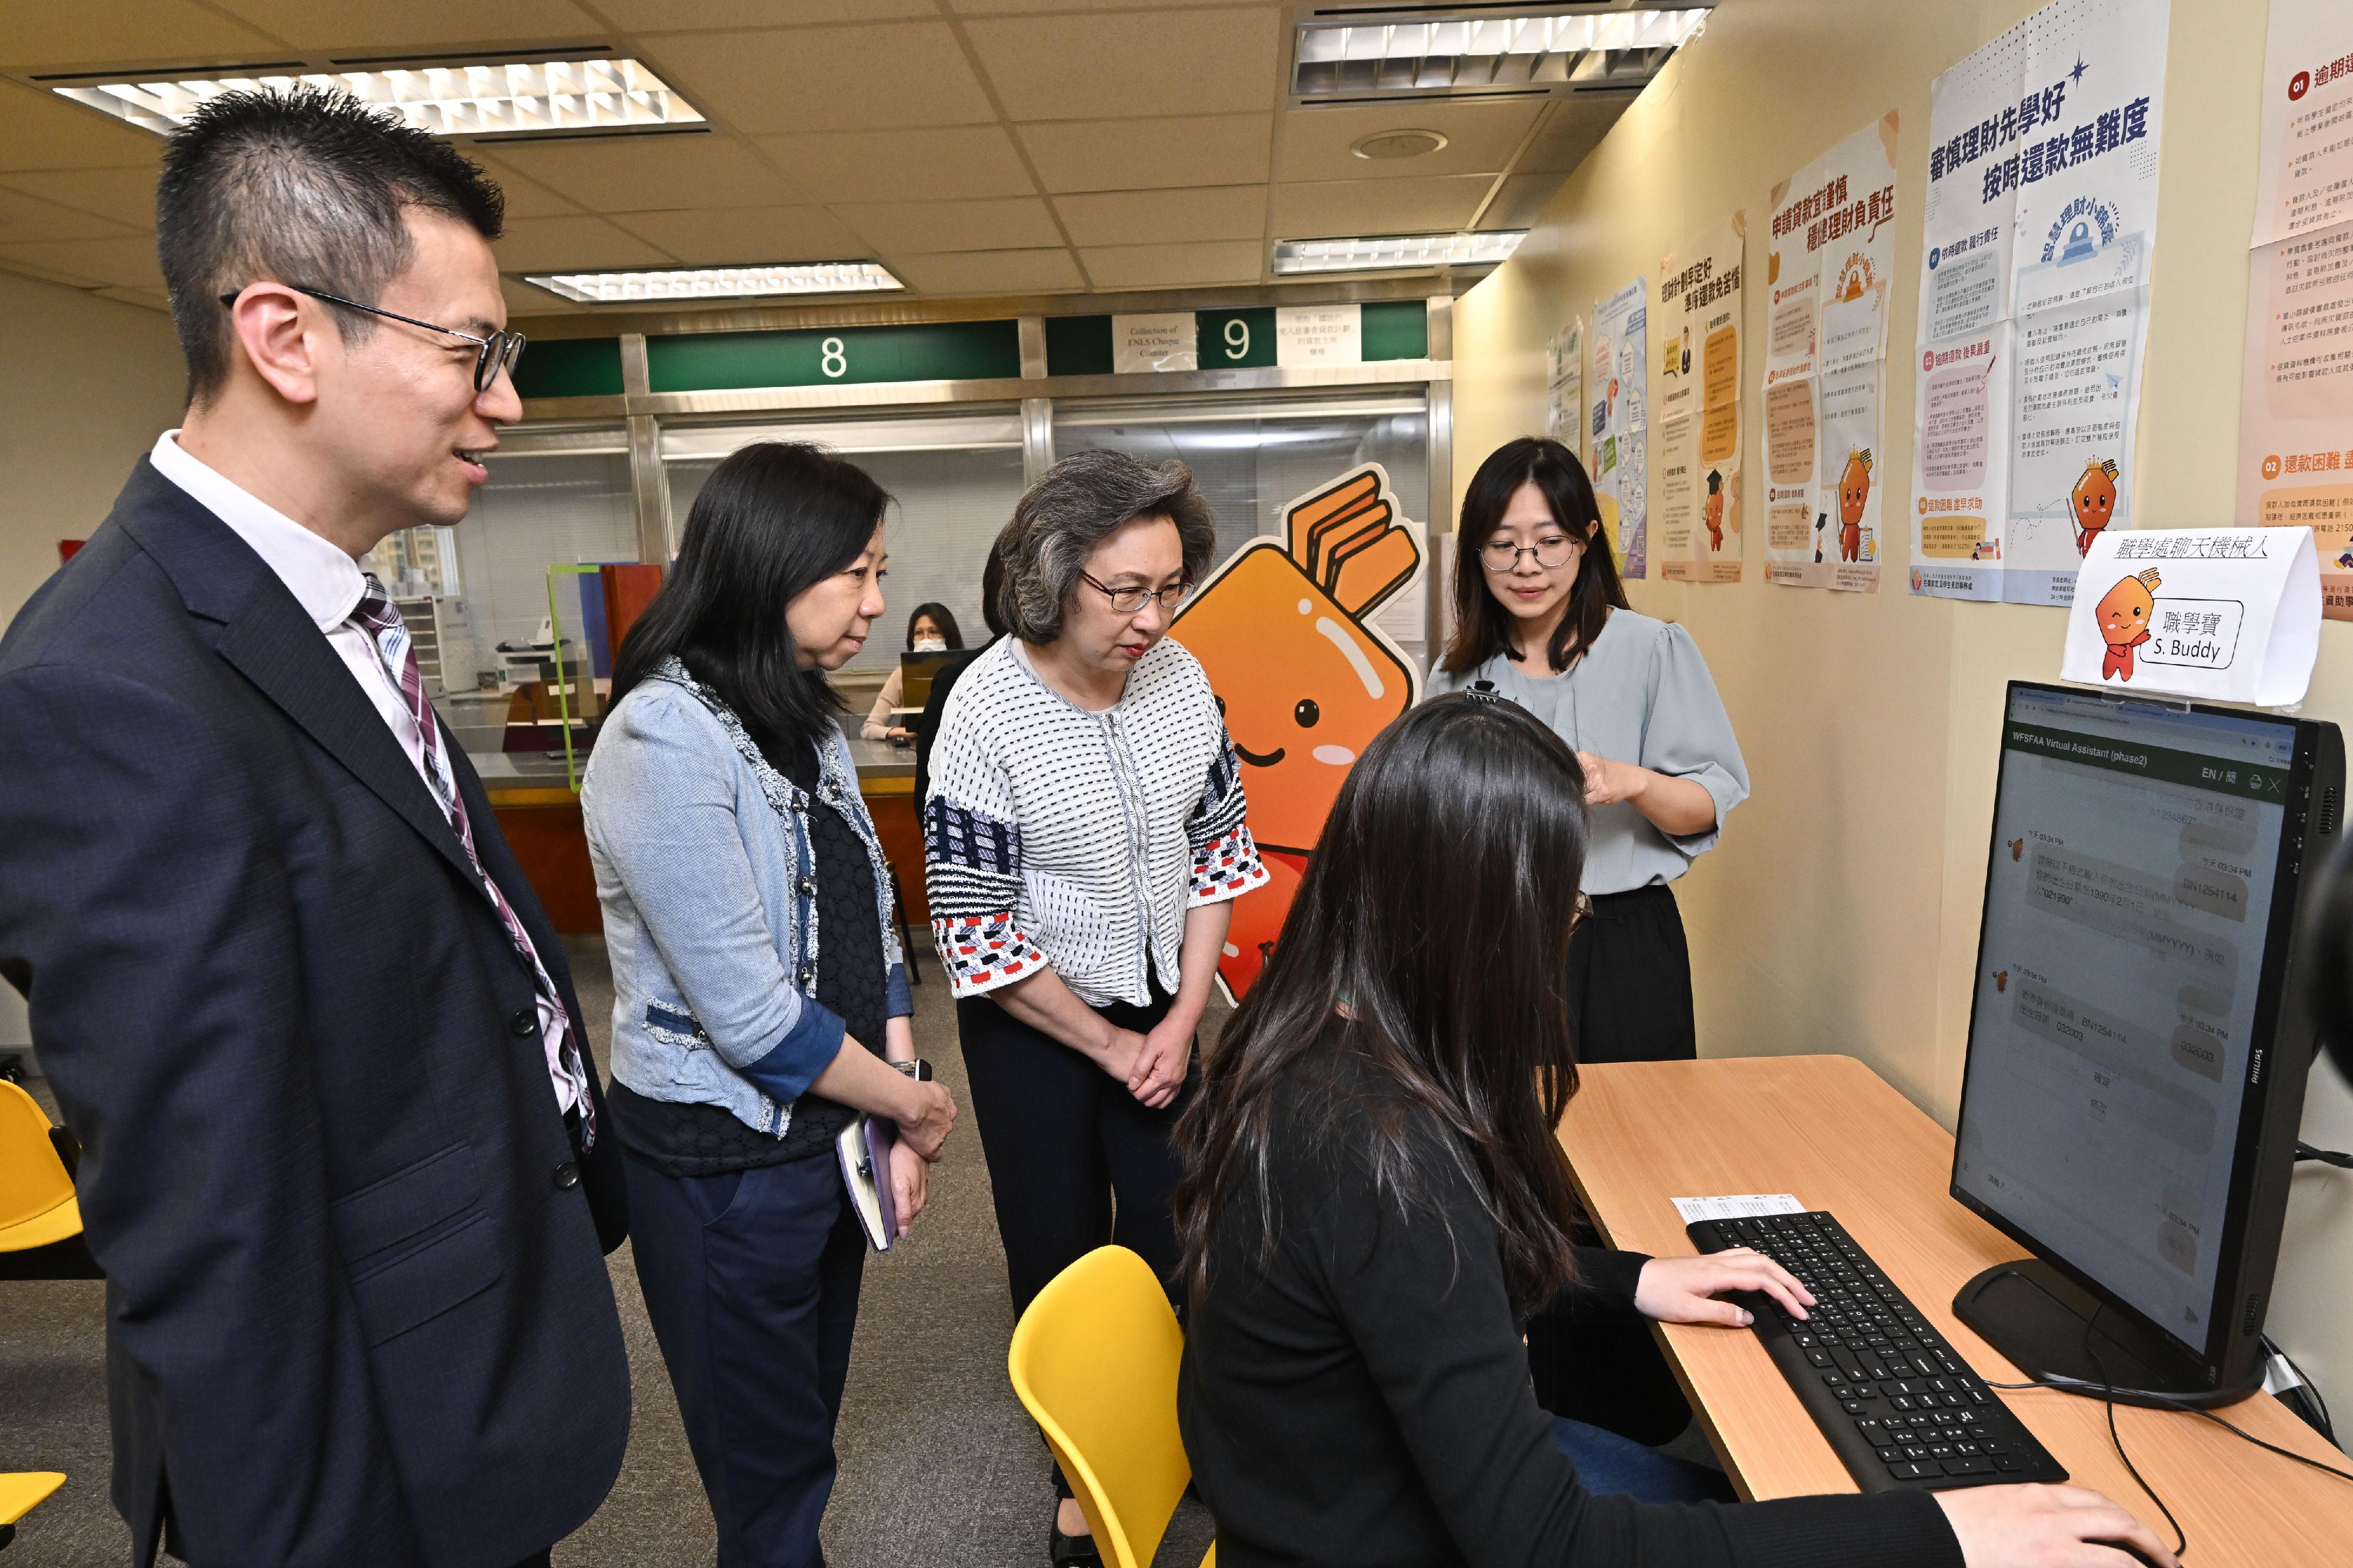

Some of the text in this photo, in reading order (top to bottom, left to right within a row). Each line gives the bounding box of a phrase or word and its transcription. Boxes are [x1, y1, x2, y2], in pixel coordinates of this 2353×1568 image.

[2294, 80, 2304, 92] 01
[1931, 81, 2065, 184] 審慎理財先學好
[1983, 96, 2149, 205] 按時還款無難度
[1772, 174, 1848, 240] 申請貸款宜謹慎
[1807, 185, 1894, 253] 穩健理財負責任
[1942, 239, 1968, 260] 依時還款
[1969, 227, 1999, 249] 履行責任
[1662, 256, 1712, 303] 理財計劃早定好
[1685, 265, 1739, 314] 準時還款免苦惱
[1130, 325, 1178, 335] Collection of
[1152, 337, 1180, 347] Cheque
[1224, 319, 1250, 359] 9
[821, 336, 847, 378] 8
[1935, 348, 1962, 366] 逾期還款
[1963, 340, 1990, 359] 後果嚴重
[2266, 462, 2277, 471] 02
[2285, 452, 2340, 473] 還款困難
[1928, 498, 1952, 512] 還款困難
[1954, 497, 1982, 511] 盡早求助
[2117, 535, 2268, 558] 職學處聊天機械人
[2162, 612, 2222, 636] 職學寶
[2154, 638, 2221, 663] S. Buddy
[2013, 731, 2148, 768] WFSFAA Virtual Assistant (phase2)
[2202, 767, 2217, 781] EN
[2226, 770, 2237, 785] 簡
[2028, 829, 2064, 847] 今天 03:34 PM
[2202, 856, 2252, 878] 今天 03:34 PM
[2184, 878, 2238, 903] BN1254114
[2023, 968, 2038, 980] 03:34
[2038, 975, 2047, 985] PM
[2056, 1022, 2084, 1042] 032003
[2082, 1016, 2127, 1045] BN1254114
[2195, 1020, 2215, 1035] 03:34
[2216, 1028, 2229, 1040] PM
[2180, 1040, 2215, 1063] 032003
[2251, 1048, 2263, 1085] PHILIPS
